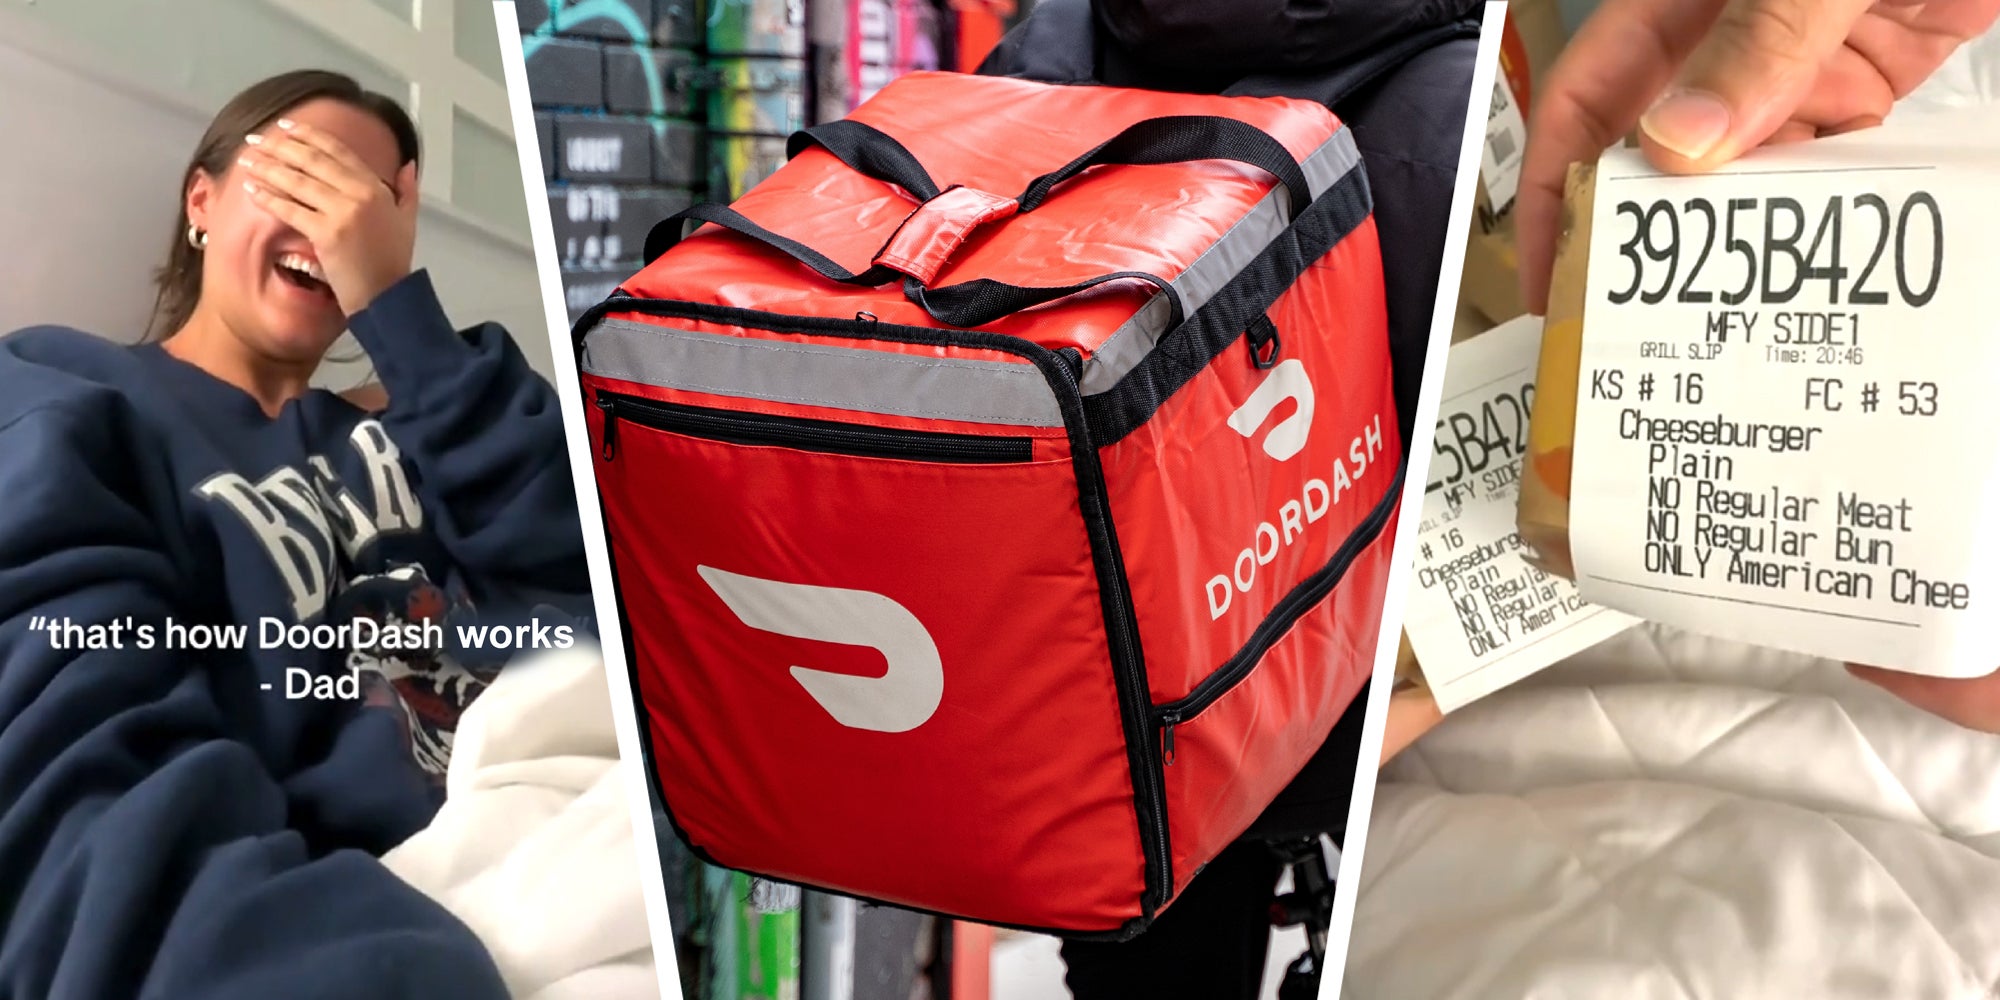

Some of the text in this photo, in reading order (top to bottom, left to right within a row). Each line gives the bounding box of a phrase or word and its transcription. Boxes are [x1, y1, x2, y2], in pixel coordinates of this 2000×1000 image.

[1607, 191, 1943, 308] 3925B420
[1706, 312, 1859, 346] MFY SIDE1
[1640, 342, 1723, 360] GRILL SLIP
[1765, 345, 1863, 365] Time: 20:46
[1591, 369, 1704, 405] KS # 16
[1804, 377, 1939, 416] FC # 53
[1619, 408, 1823, 452] Cheeseburger
[1649, 443, 1733, 481] Plain
[1206, 414, 1383, 621] DOORDASH
[1649, 476, 1913, 532] NO Regular Meat
[1440, 527, 1464, 552] 16
[1647, 509, 1894, 567] NO Regular Bun
[1445, 565, 1500, 599] Plain
[1644, 541, 1970, 610] ONLY American Chee
[1454, 593, 1478, 620] NO
[1461, 580, 1559, 639] NO Regular
[1468, 620, 1512, 658] ONLY
